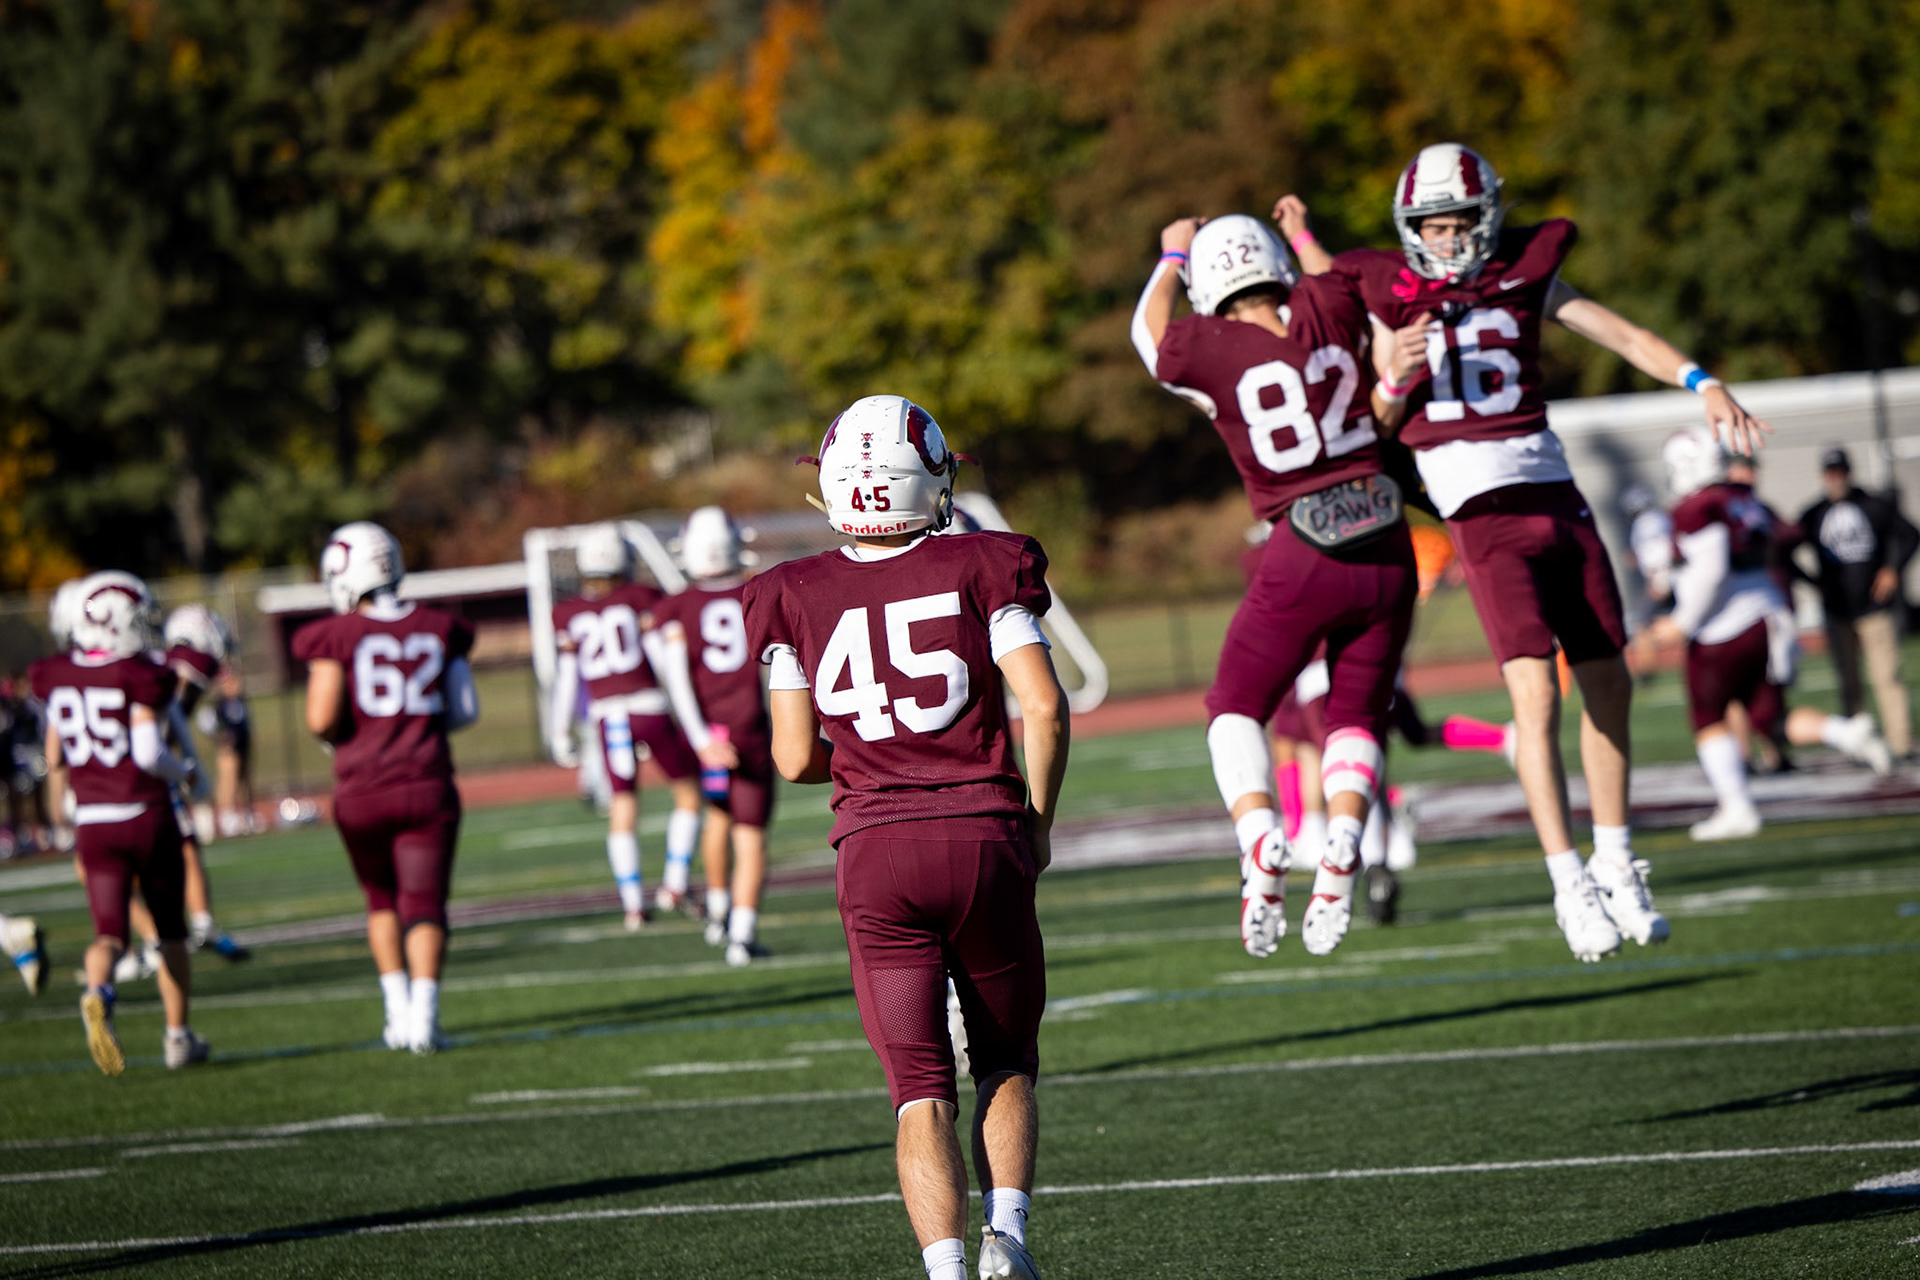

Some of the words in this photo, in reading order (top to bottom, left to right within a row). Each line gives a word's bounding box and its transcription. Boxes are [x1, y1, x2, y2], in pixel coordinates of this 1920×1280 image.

[1218, 244, 1254, 271] 32
[1423, 306, 1524, 423] 16
[1235, 344, 1378, 474] 82
[841, 521, 907, 535] Riddell
[851, 485, 891, 512] 45
[1310, 489, 1392, 533] DAWG
[568, 604, 643, 681] 20
[700, 598, 749, 673] 9
[814, 591, 969, 742] 45
[353, 634, 446, 718] 62
